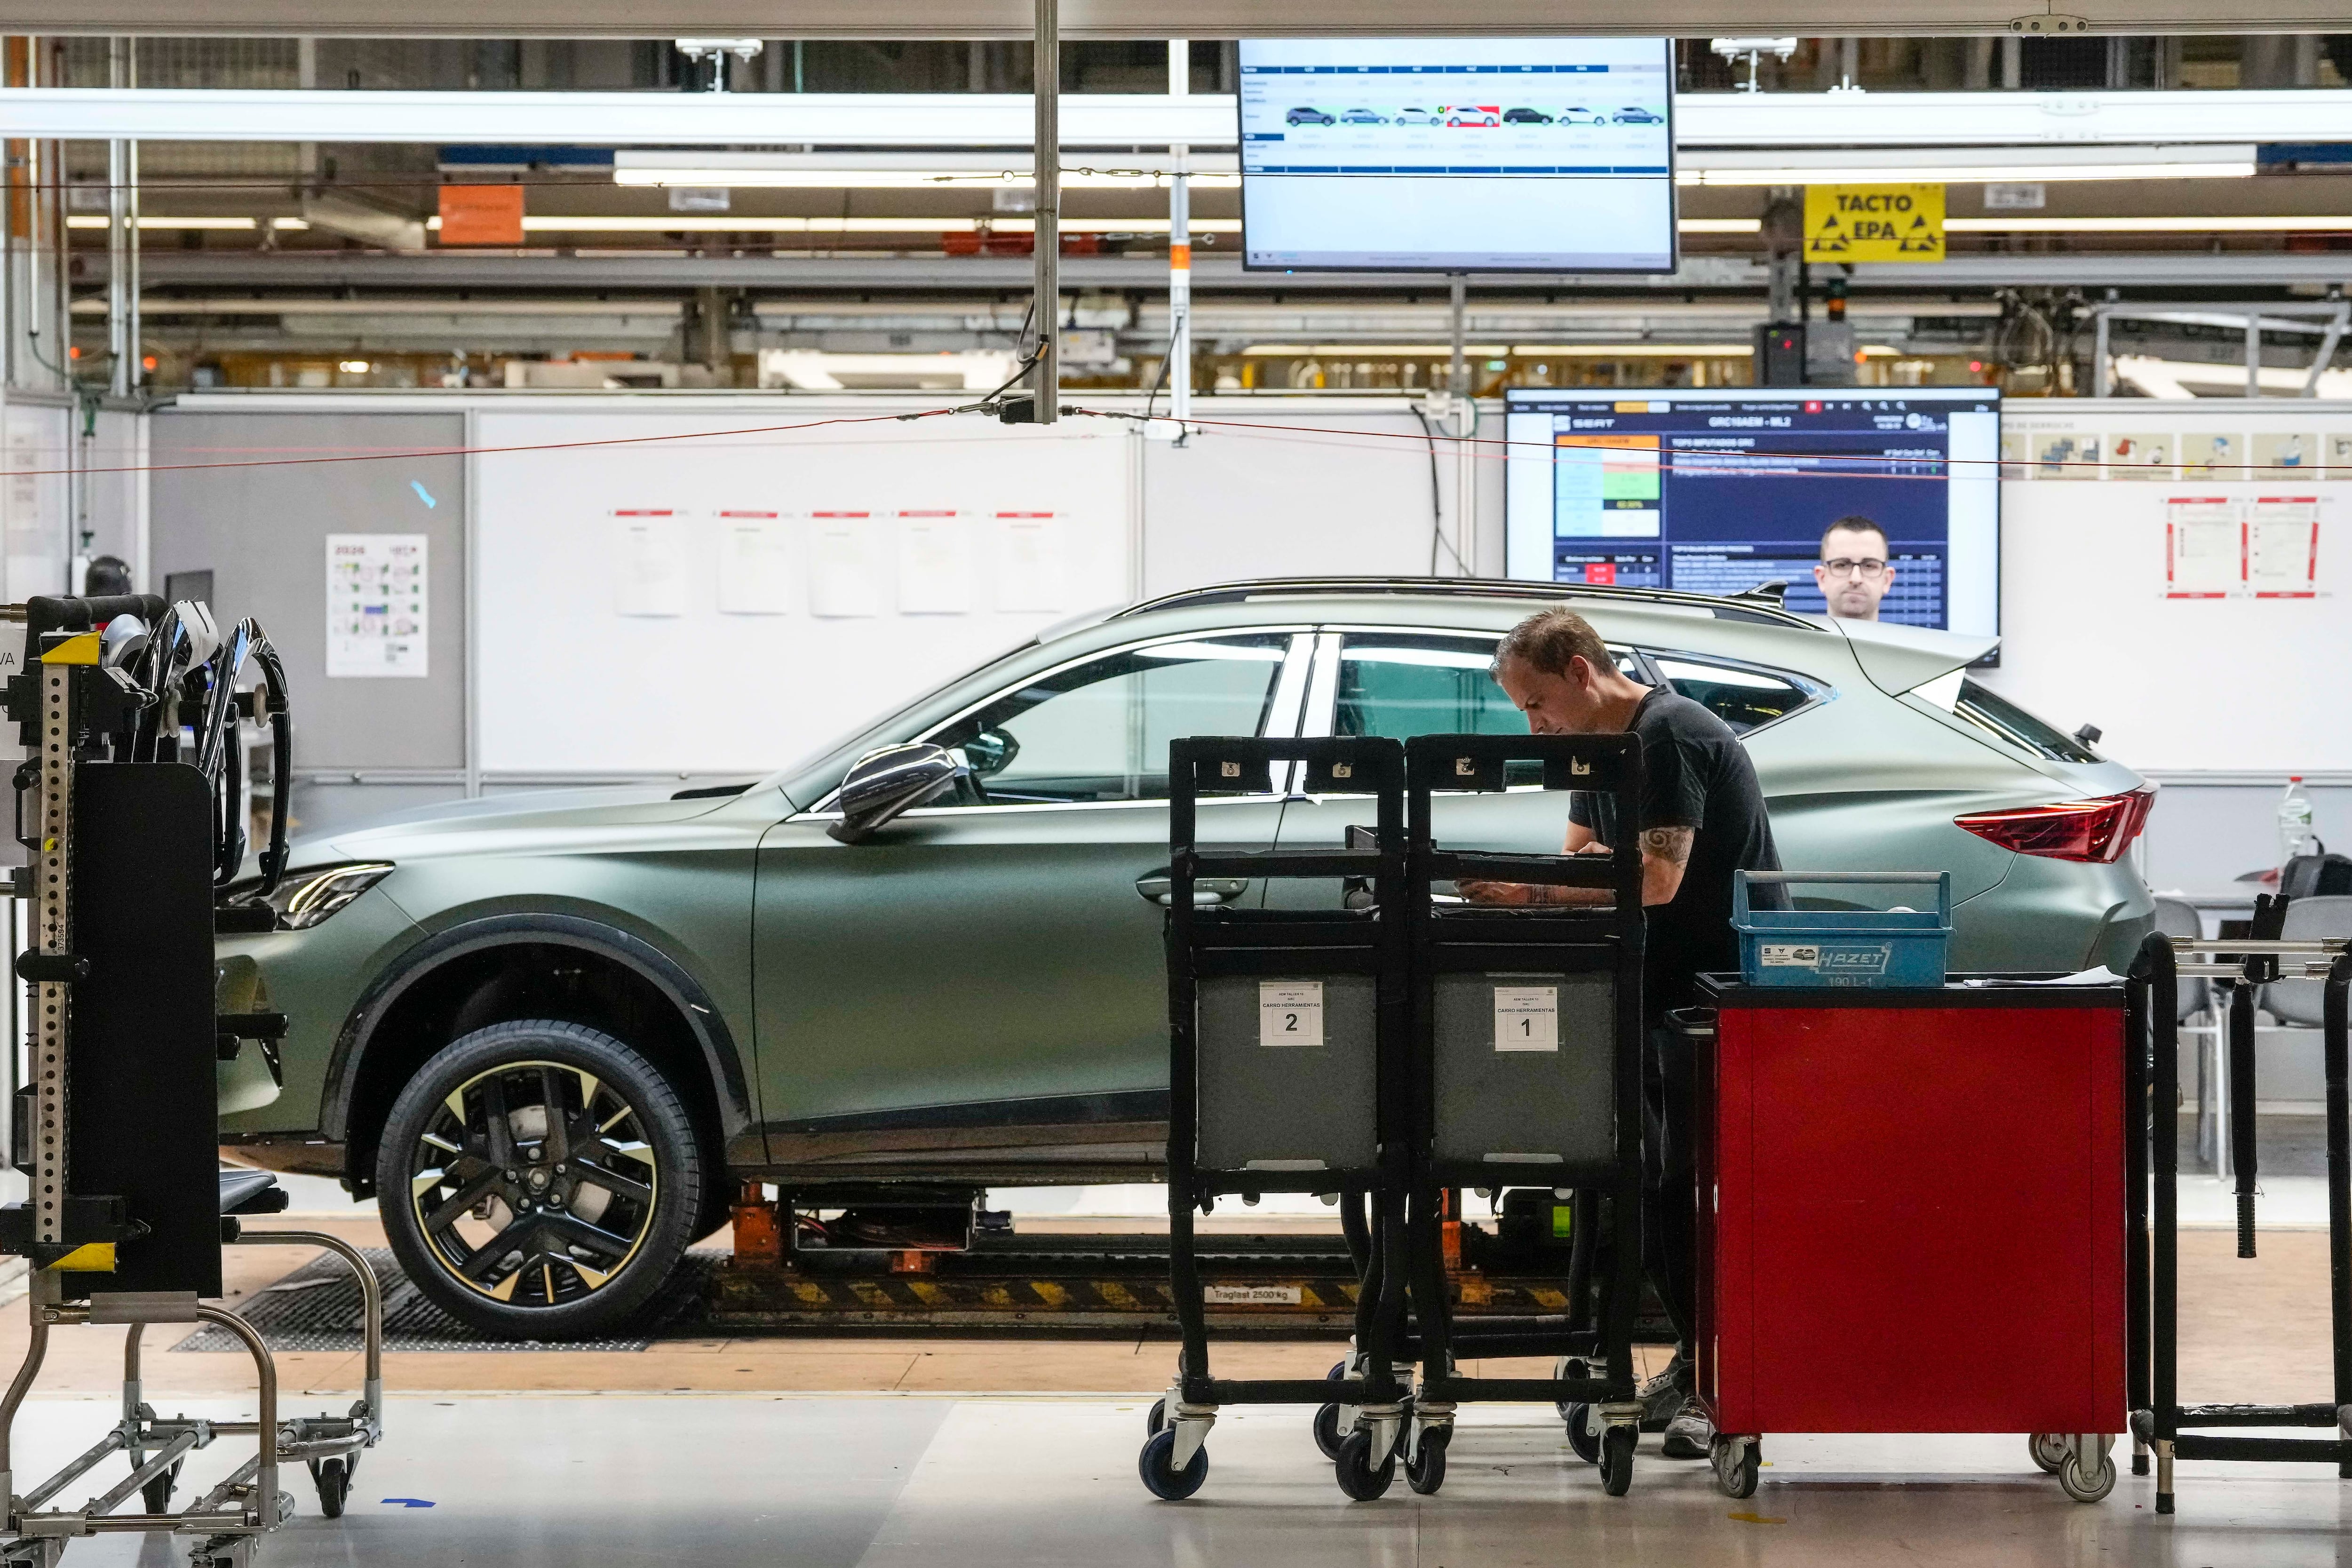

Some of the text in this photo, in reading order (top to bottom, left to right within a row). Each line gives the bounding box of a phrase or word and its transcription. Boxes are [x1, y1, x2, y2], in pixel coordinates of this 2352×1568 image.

[1835, 194, 1913, 212] TACTO
[1853, 222, 1897, 239] EPA
[1573, 418, 1615, 429] SEAT
[1818, 953, 1883, 967] HAZET
[1285, 1013, 1298, 1031] 2
[1521, 1019, 1530, 1036] 1
[1215, 1290, 1288, 1300] Traglast 2500 kg
